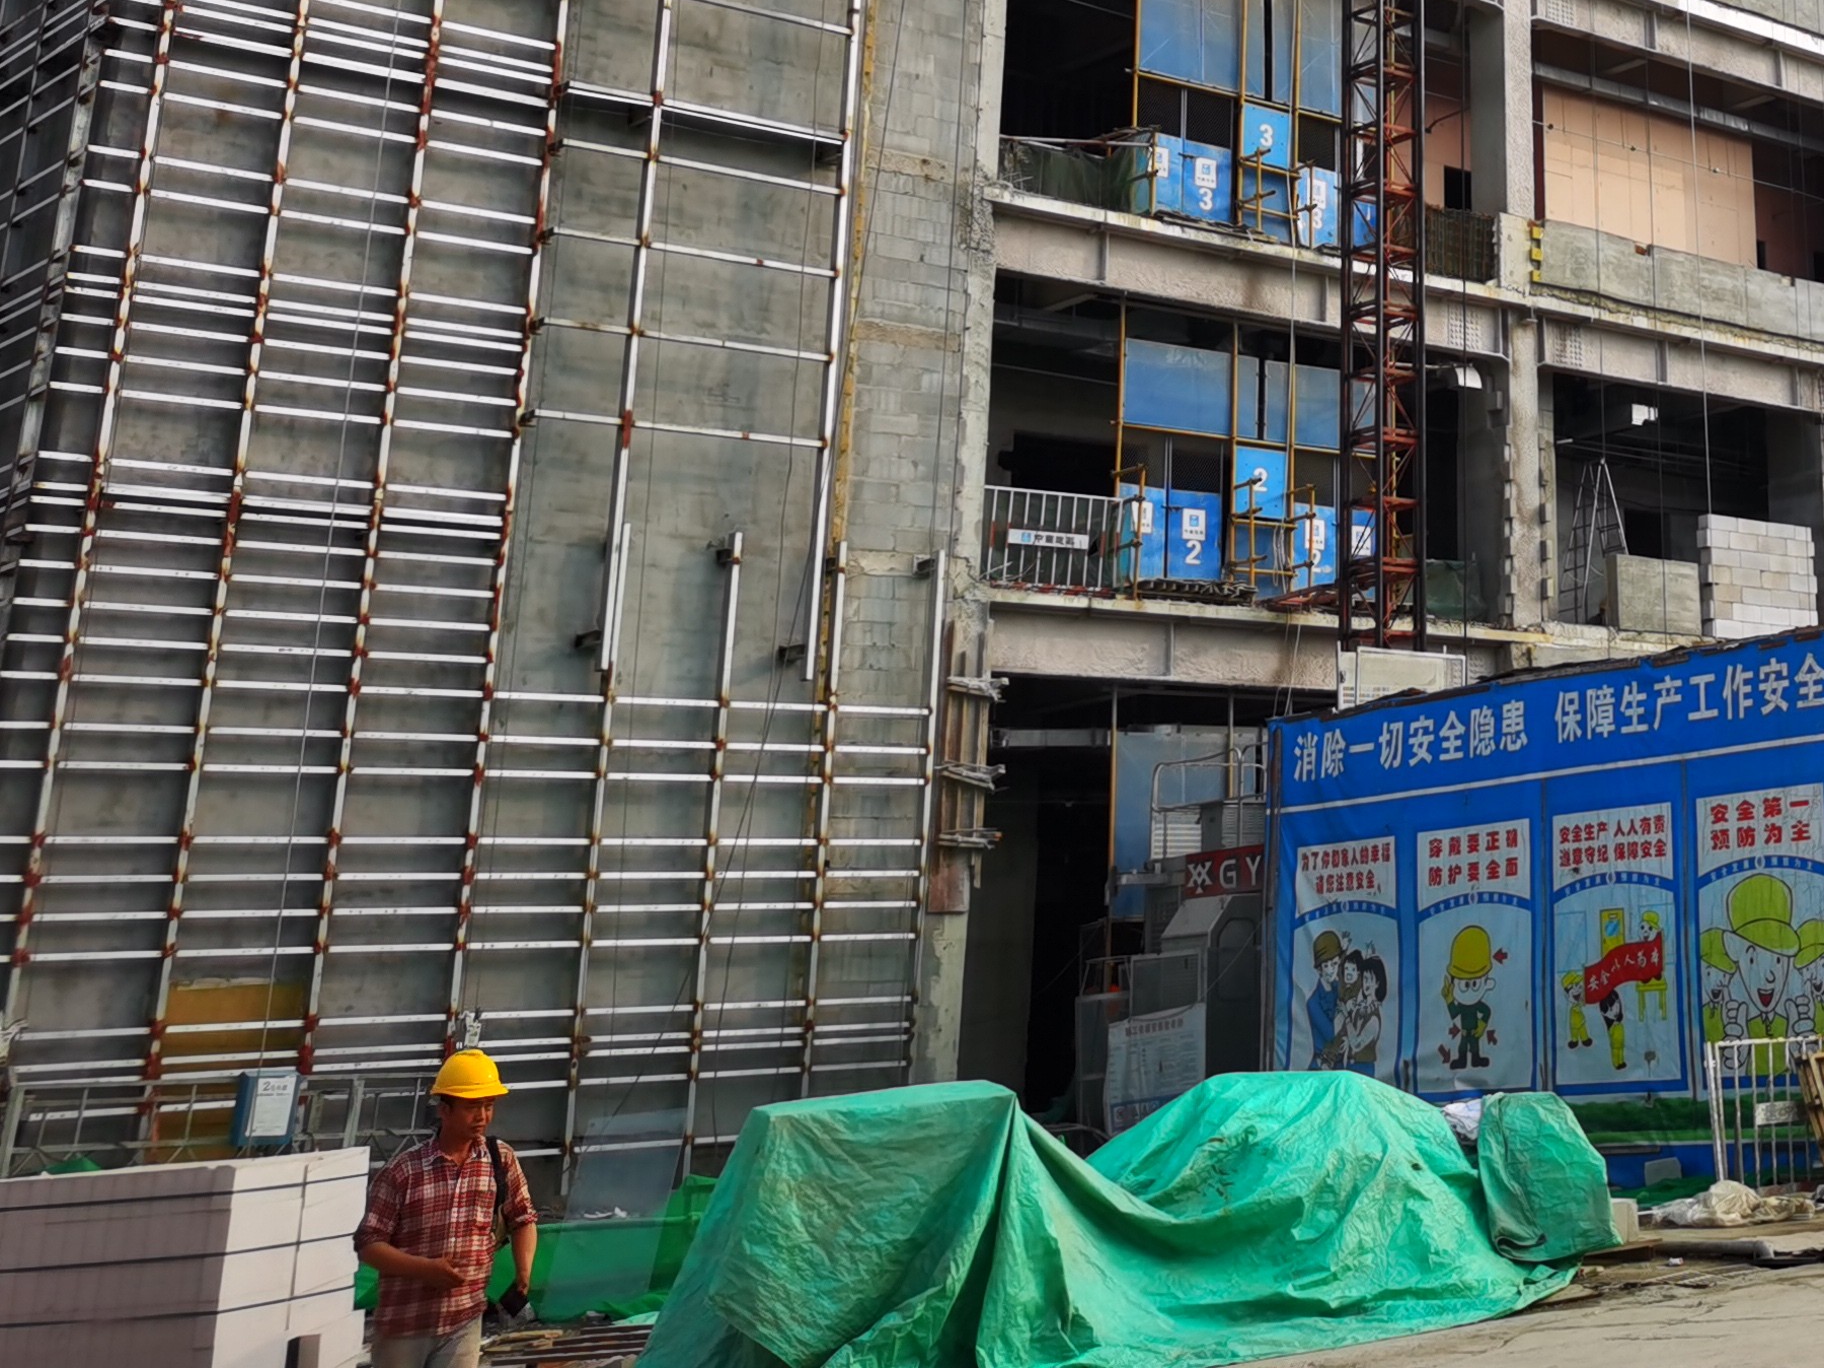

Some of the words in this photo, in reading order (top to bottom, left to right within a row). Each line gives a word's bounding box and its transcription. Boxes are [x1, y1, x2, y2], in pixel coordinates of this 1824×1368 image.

[1259, 123, 1274, 147] 3
[1198, 188, 1214, 211] 3
[1252, 467, 1268, 492] 2
[1184, 539, 1202, 565] 2
[1293, 699, 1529, 782] 消除一切安全隐患
[1710, 796, 1810, 825] 安全第一
[1428, 828, 1519, 859] 穿戴要正确
[1559, 820, 1608, 845] 安全生产
[1613, 814, 1665, 838] 人人有责
[1710, 820, 1812, 851] 预防为主
[1613, 838, 1667, 862] 保障安全
[1428, 857, 1519, 887] 防护要全面
